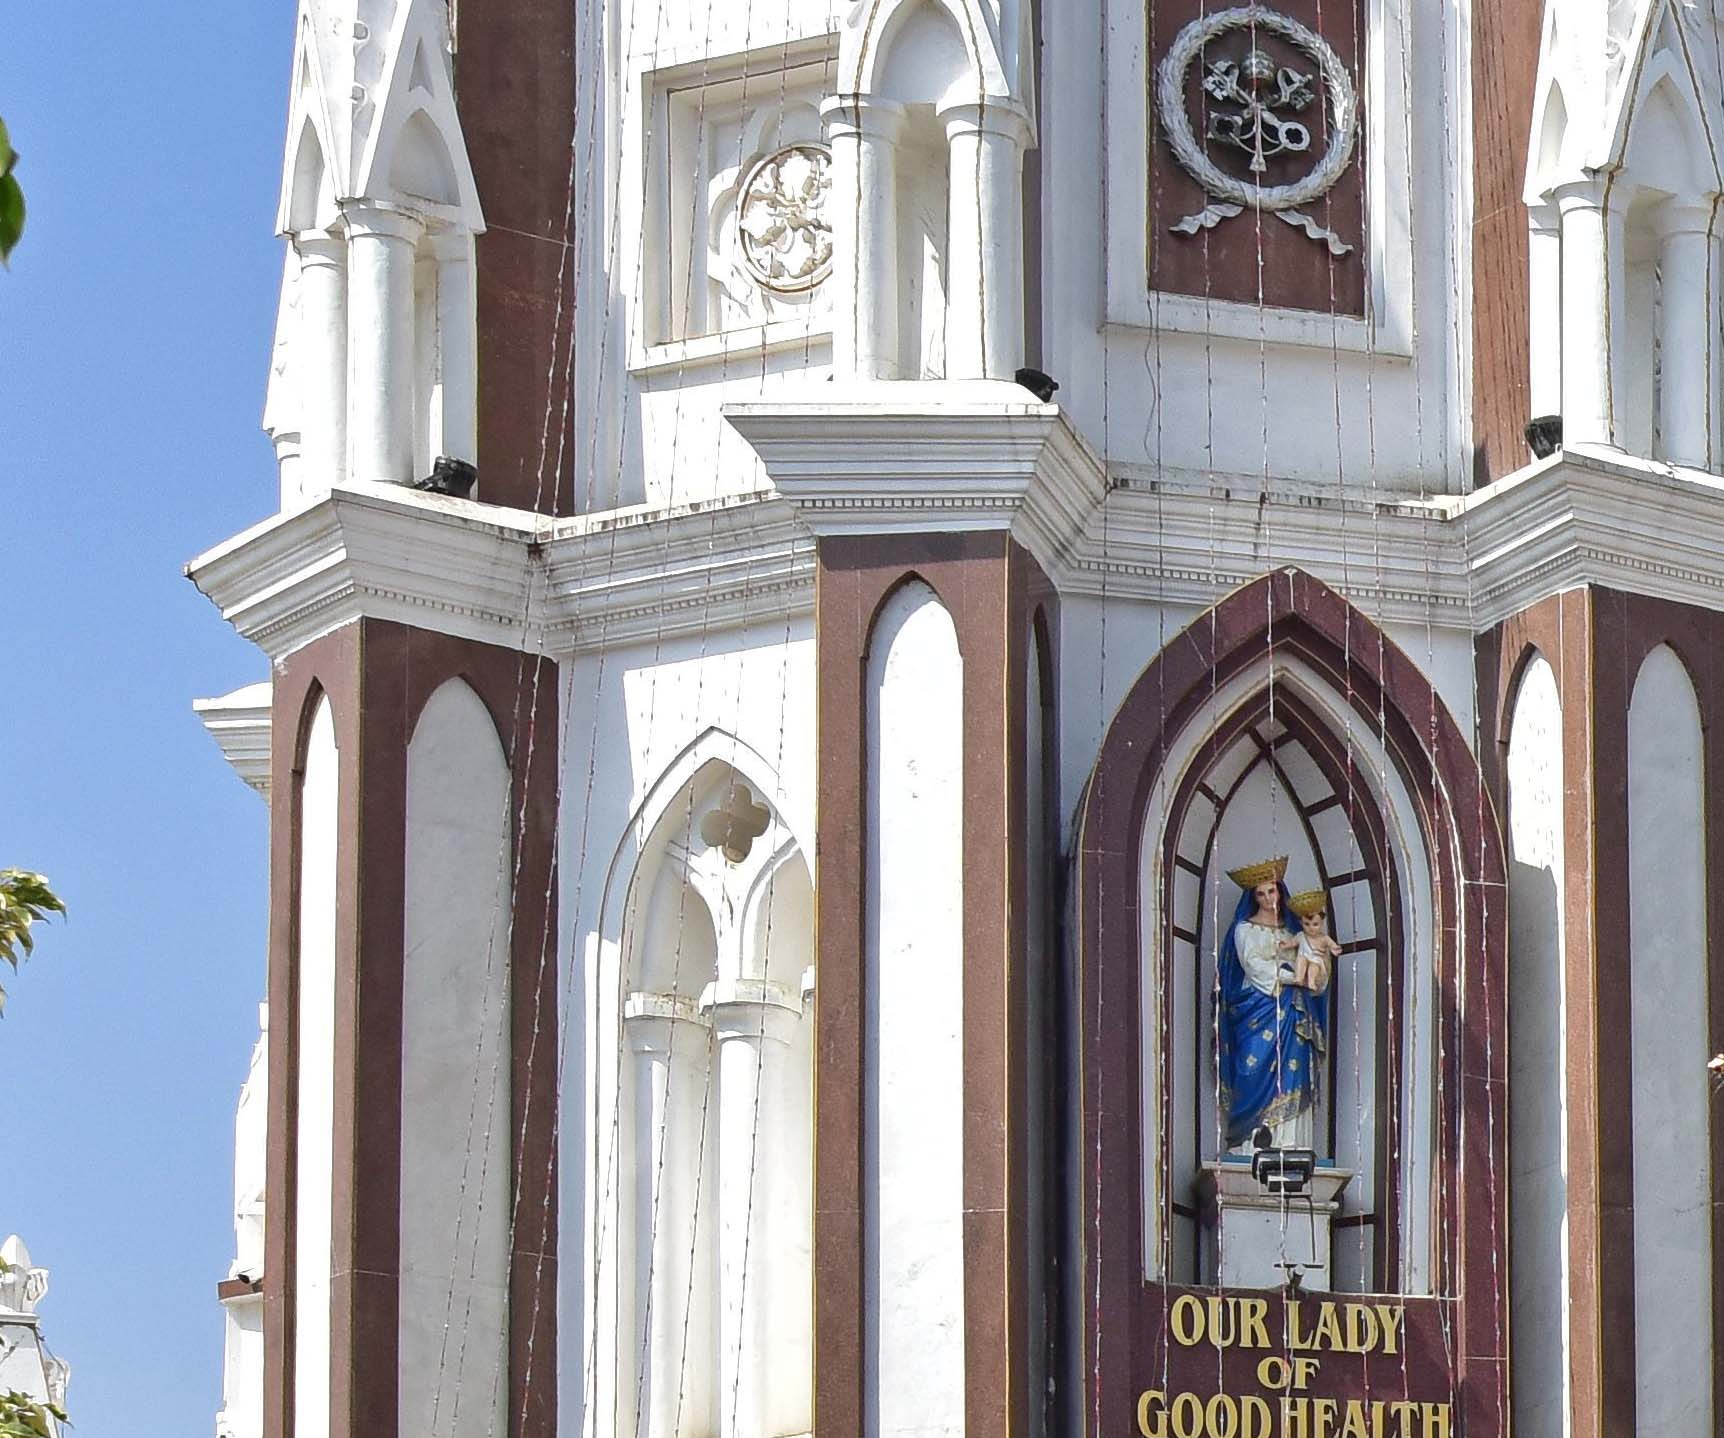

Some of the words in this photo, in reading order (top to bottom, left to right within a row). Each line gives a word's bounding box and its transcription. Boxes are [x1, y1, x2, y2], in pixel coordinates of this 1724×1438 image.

[1170, 1294, 1272, 1349] OUR
[1285, 1299, 1407, 1355] LADY
[1256, 1356, 1321, 1391] OF
